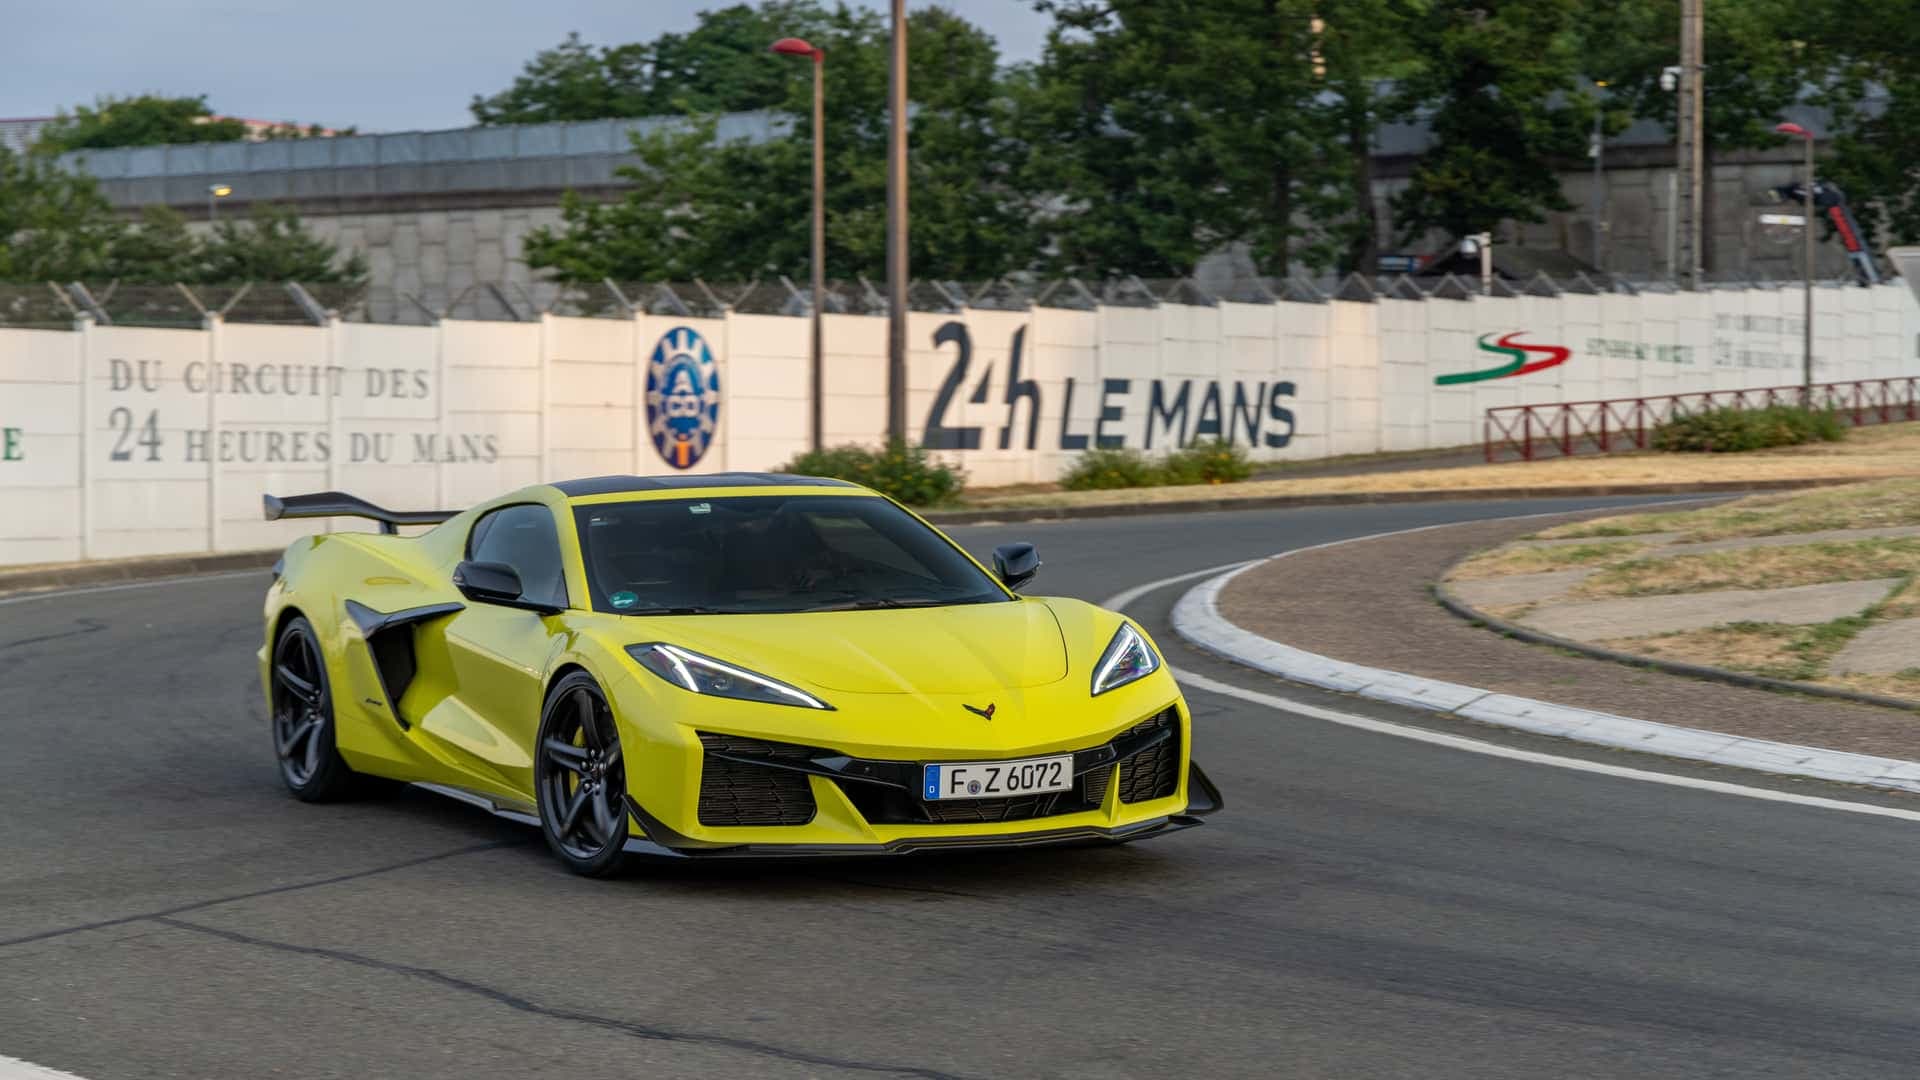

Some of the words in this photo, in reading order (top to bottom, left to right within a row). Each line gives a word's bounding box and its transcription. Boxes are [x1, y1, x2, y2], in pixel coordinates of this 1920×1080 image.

[109, 358, 162, 392] DU
[184, 361, 345, 397] CIRCUIT
[365, 367, 430, 399] DES
[108, 405, 164, 462] 24
[184, 430, 332, 464] HEURES
[349, 431, 396, 464] DU
[411, 432, 498, 464] MANS
[1059, 377, 1131, 450] LE
[1144, 379, 1298, 450] MANS
[951, 768, 967, 794] F
[984, 767, 1001, 793] Z
[1007, 761, 1062, 791] 6072
